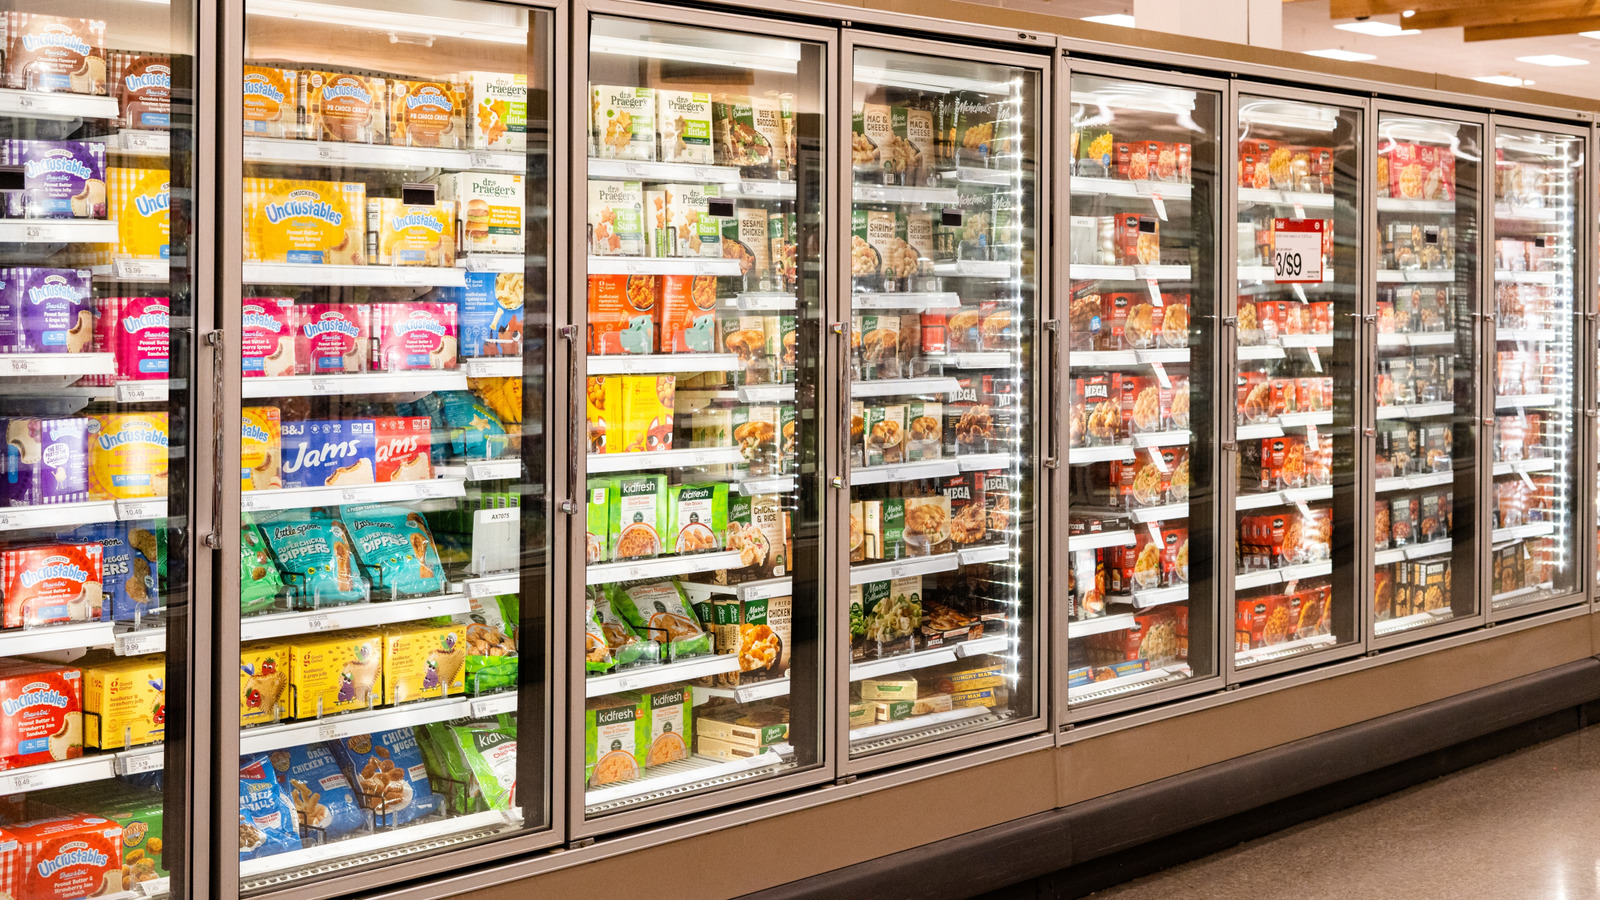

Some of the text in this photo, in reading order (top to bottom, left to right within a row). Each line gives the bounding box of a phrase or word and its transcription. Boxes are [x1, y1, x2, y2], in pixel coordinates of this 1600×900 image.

[22, 33, 92, 57] Uncrustables
[322, 85, 371, 104] Uncrustables
[486, 82, 527, 97] Praeger's
[406, 94, 453, 112] Uncrustables
[611, 96, 648, 108] Praeger's
[668, 101, 705, 113] Praeger's
[866, 115, 881, 124] MAC
[909, 120, 922, 128] MAC
[866, 123, 889, 132] CHEESE
[909, 129, 930, 138] CHEESE
[472, 182, 516, 196] Praeger's
[599, 190, 636, 202] Praeger's
[265, 200, 343, 227] Uncrustables
[617, 210, 636, 220] Pizza
[392, 214, 444, 232] Uncrustables
[617, 220, 637, 231] Stars
[700, 224, 716, 234] Stars
[742, 220, 764, 228] SESAME
[870, 223, 894, 233] SHRIMP
[742, 228, 764, 237] CHICKEN
[910, 226, 930, 234] SHRIMP
[1276, 252, 1302, 278] 3/$9
[28, 283, 82, 305] Uncrustables
[304, 320, 360, 338] Uncrustables
[394, 318, 446, 338] Uncrustables
[128, 390, 144, 398] 10.49
[949, 388, 978, 403] MEGA
[1084, 384, 1108, 398] MEGA
[282, 425, 304, 436] B&J
[282, 439, 360, 474] Jams
[623, 482, 656, 494] kidfresh
[943, 486, 970, 500] MEGA
[126, 508, 142, 516] 10.49
[764, 514, 777, 522] RICE
[278, 544, 296, 555] SUPER
[280, 544, 331, 564] DIPPERS
[21, 563, 88, 588] Uncrustables
[748, 605, 766, 616] Marie
[769, 609, 791, 618] CHICKEN
[309, 620, 322, 628] 9.99
[2, 689, 68, 717] Uncrustables
[653, 693, 682, 706] kidfresh
[34, 718, 50, 726] Butter
[599, 709, 634, 724] kidfresh
[292, 760, 324, 775] CHICKEN
[14, 779, 30, 787] 10.49
[38, 849, 108, 878] Uncrustables
